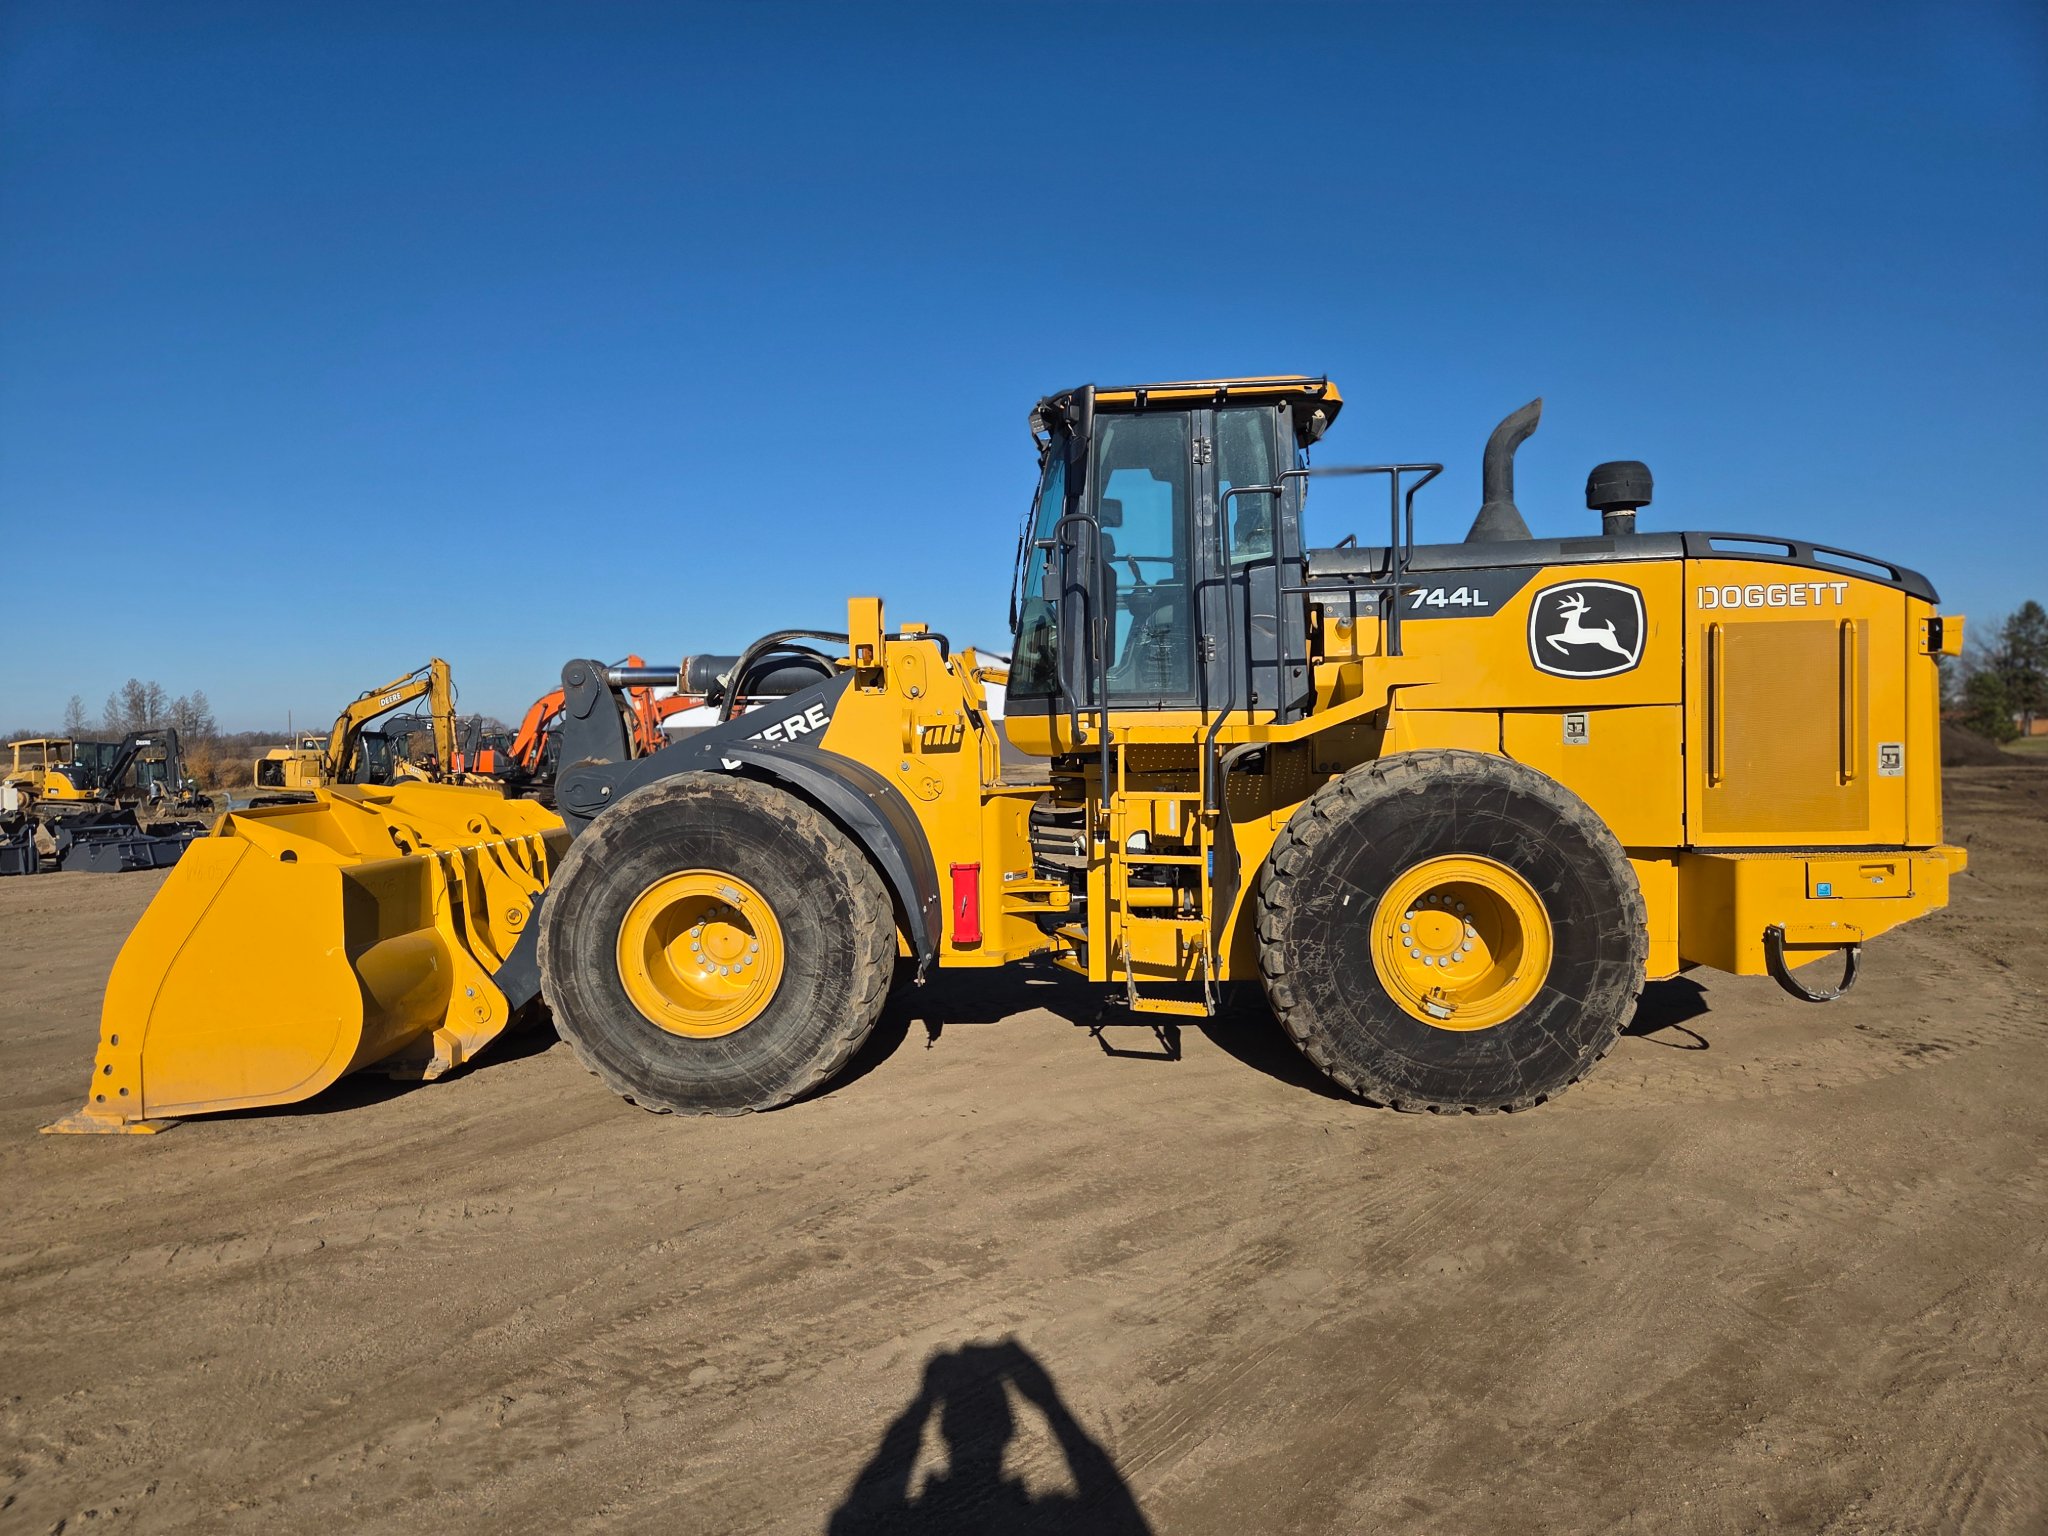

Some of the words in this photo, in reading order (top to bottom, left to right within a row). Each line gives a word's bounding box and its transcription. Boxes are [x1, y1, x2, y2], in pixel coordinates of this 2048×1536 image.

[1408, 586, 1489, 609] 744L
[1697, 581, 1849, 610] DOGGETT
[380, 692, 402, 707] DEERE
[720, 702, 831, 770] ERE
